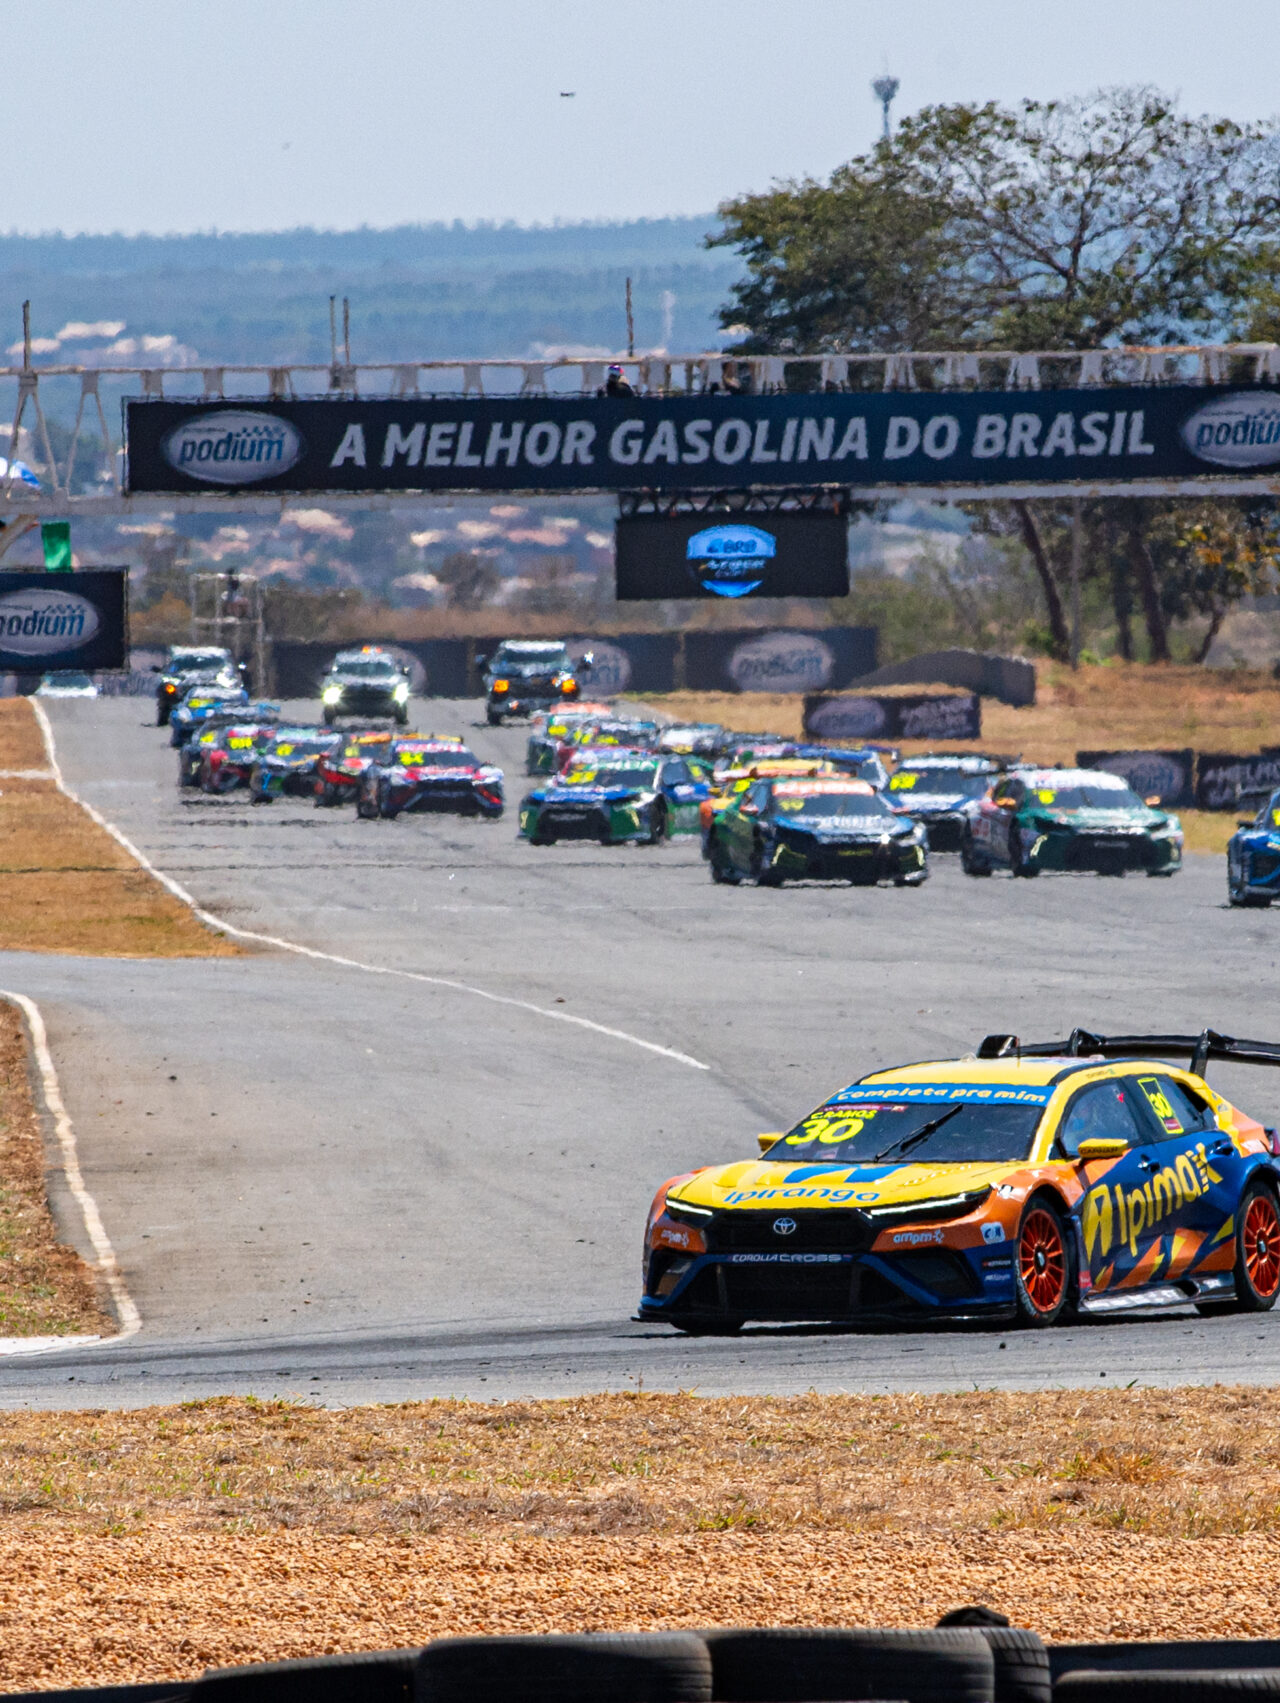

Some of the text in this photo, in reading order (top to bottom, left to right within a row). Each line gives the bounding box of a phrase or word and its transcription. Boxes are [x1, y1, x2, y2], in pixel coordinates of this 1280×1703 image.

[180, 432, 283, 466] podium
[330, 410, 1155, 468] A MELHOR GASOLINA DO BRASIL
[949, 1087, 991, 1099] pra
[994, 1090, 1046, 1103] mim
[1148, 1092, 1174, 1118] 30
[785, 1118, 865, 1145] 30
[892, 1230, 933, 1246] ampm
[732, 1253, 842, 1263] COROLLA CROSS
